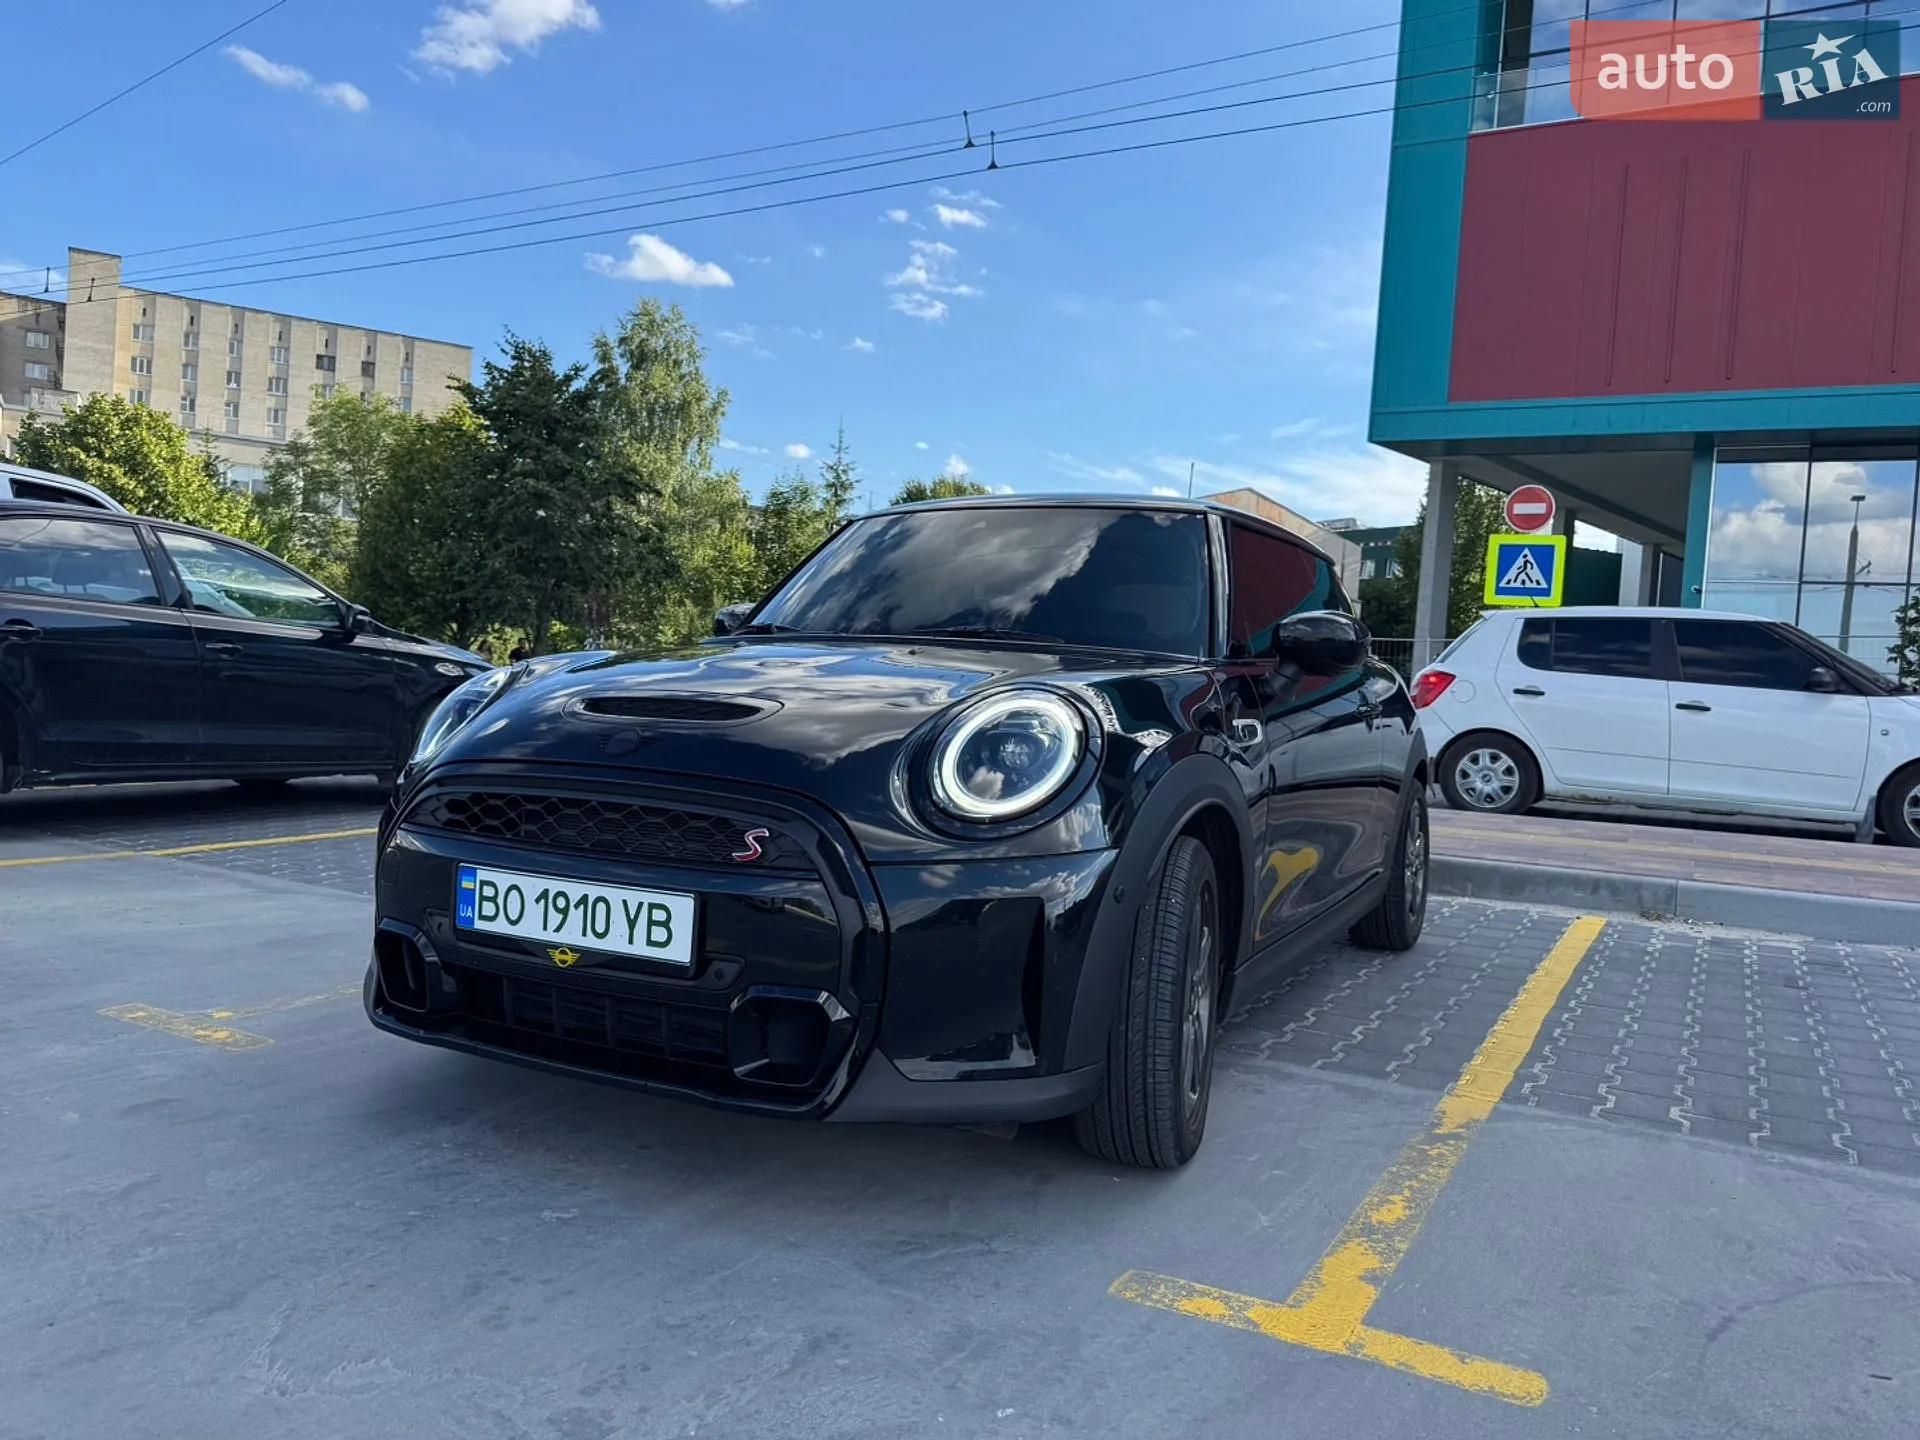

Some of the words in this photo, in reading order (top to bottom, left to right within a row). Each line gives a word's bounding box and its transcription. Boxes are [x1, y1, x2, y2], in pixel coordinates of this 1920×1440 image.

[731, 828, 770, 861] S
[459, 903, 474, 918] UA
[477, 879, 525, 926] BO
[534, 888, 612, 940] 1910
[621, 898, 674, 949] YB
